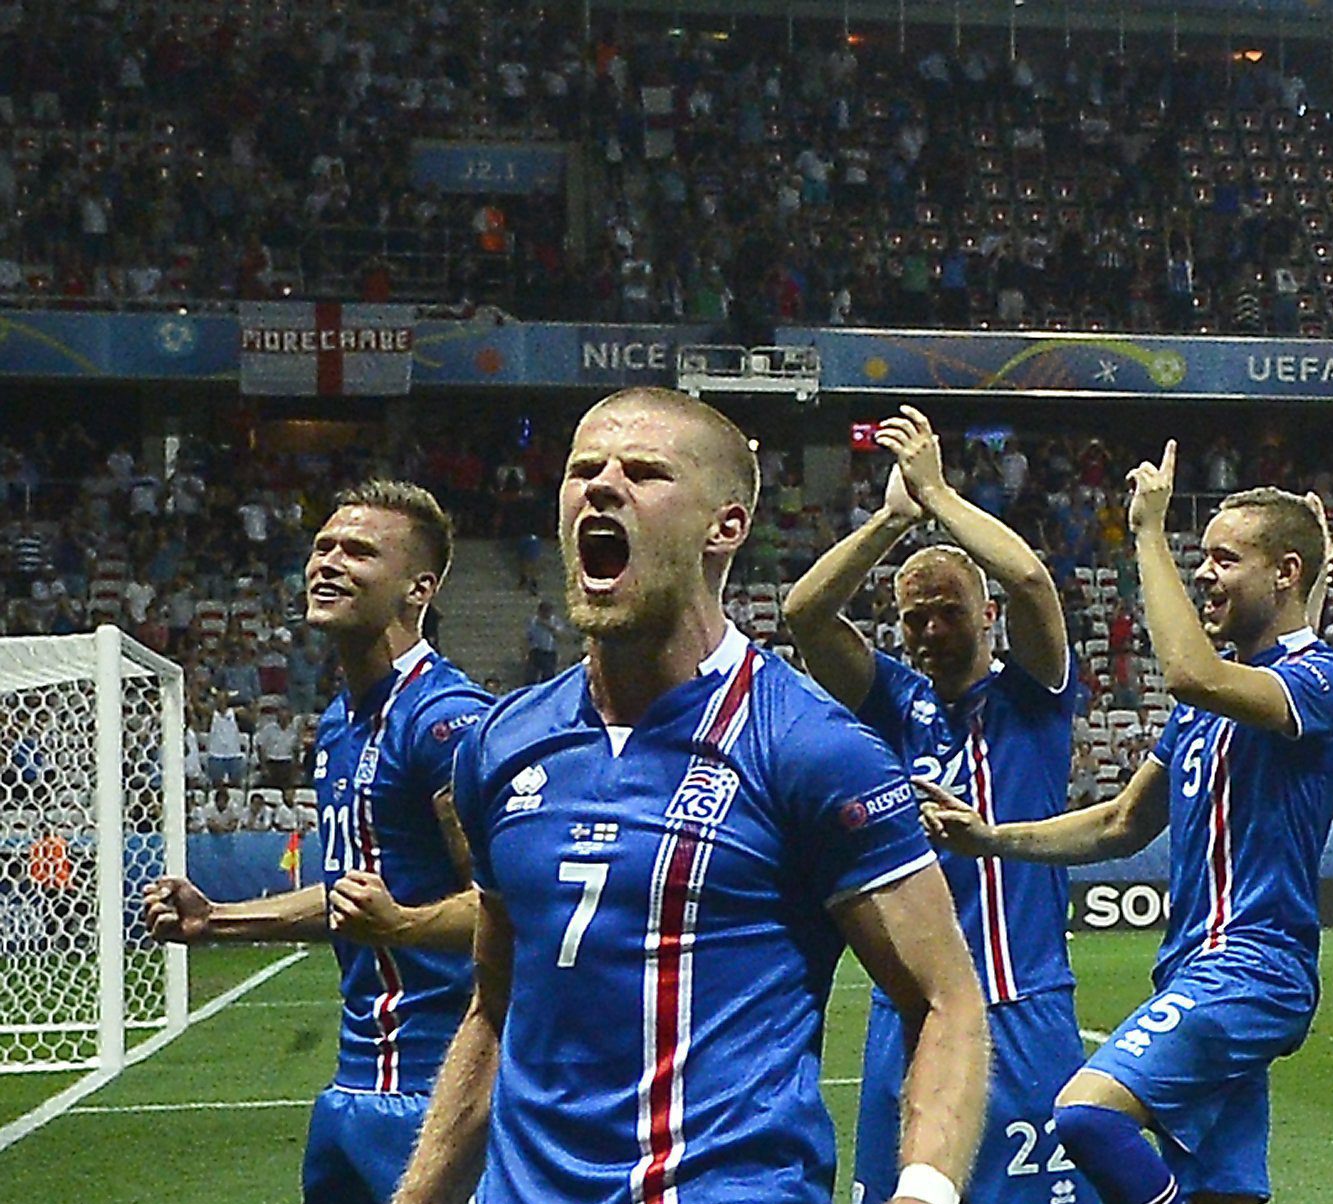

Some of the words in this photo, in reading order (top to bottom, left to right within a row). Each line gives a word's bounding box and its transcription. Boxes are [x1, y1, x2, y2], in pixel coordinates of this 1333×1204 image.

[583, 342, 667, 370] NICE
[1182, 738, 1206, 797] 5
[322, 804, 353, 872] 21
[557, 861, 609, 968] 7
[1136, 991, 1197, 1034] 5
